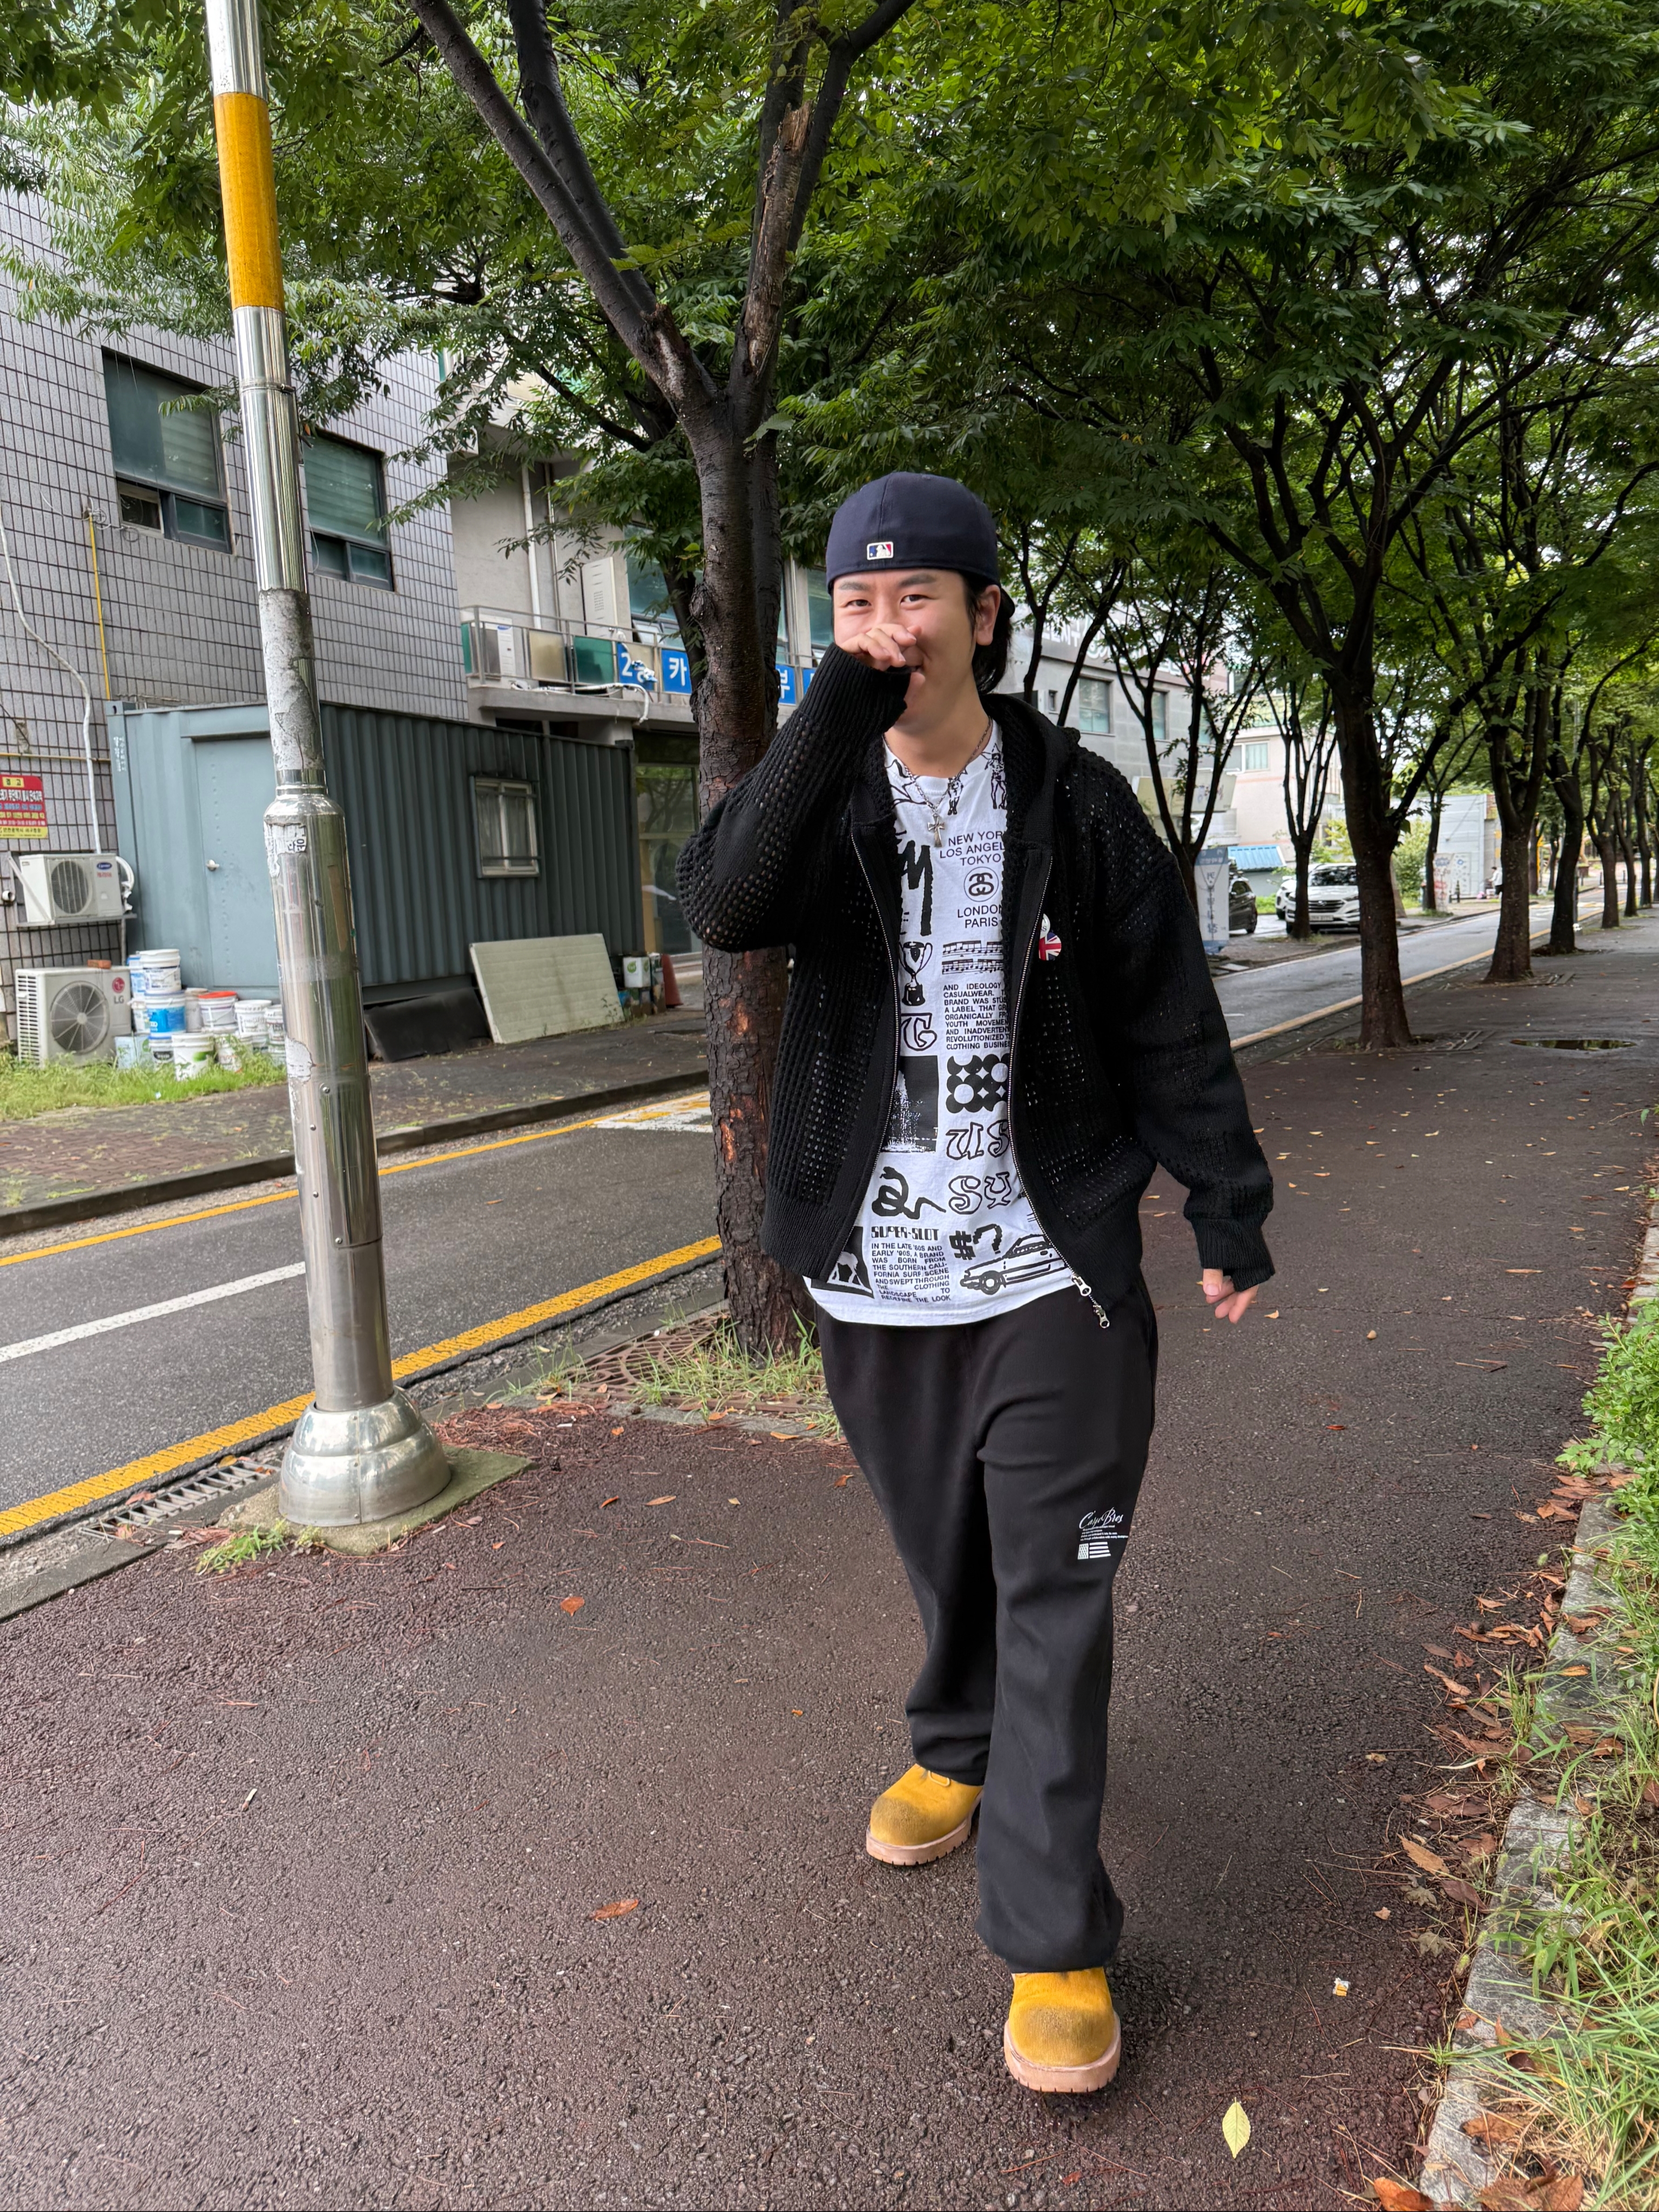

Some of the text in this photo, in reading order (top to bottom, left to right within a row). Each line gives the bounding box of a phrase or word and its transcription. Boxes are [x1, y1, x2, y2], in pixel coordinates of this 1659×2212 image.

[948, 831, 1003, 847] NEW YOR
[940, 842, 1005, 859] LOS ANGEL
[960, 853, 1001, 866] TOKYO
[965, 917, 999, 928] PARIS
[943, 990, 994, 998] CASUALWEAR.
[113, 995, 124, 1004] LG
[945, 1013, 993, 1021] ORGANICALLY
[946, 1034, 1004, 1042] REVOLUTIONIZED
[925, 1267, 949, 1277] SCENE
[914, 1274, 949, 1283] THROUGH
[914, 1280, 949, 1290] CLOTHING
